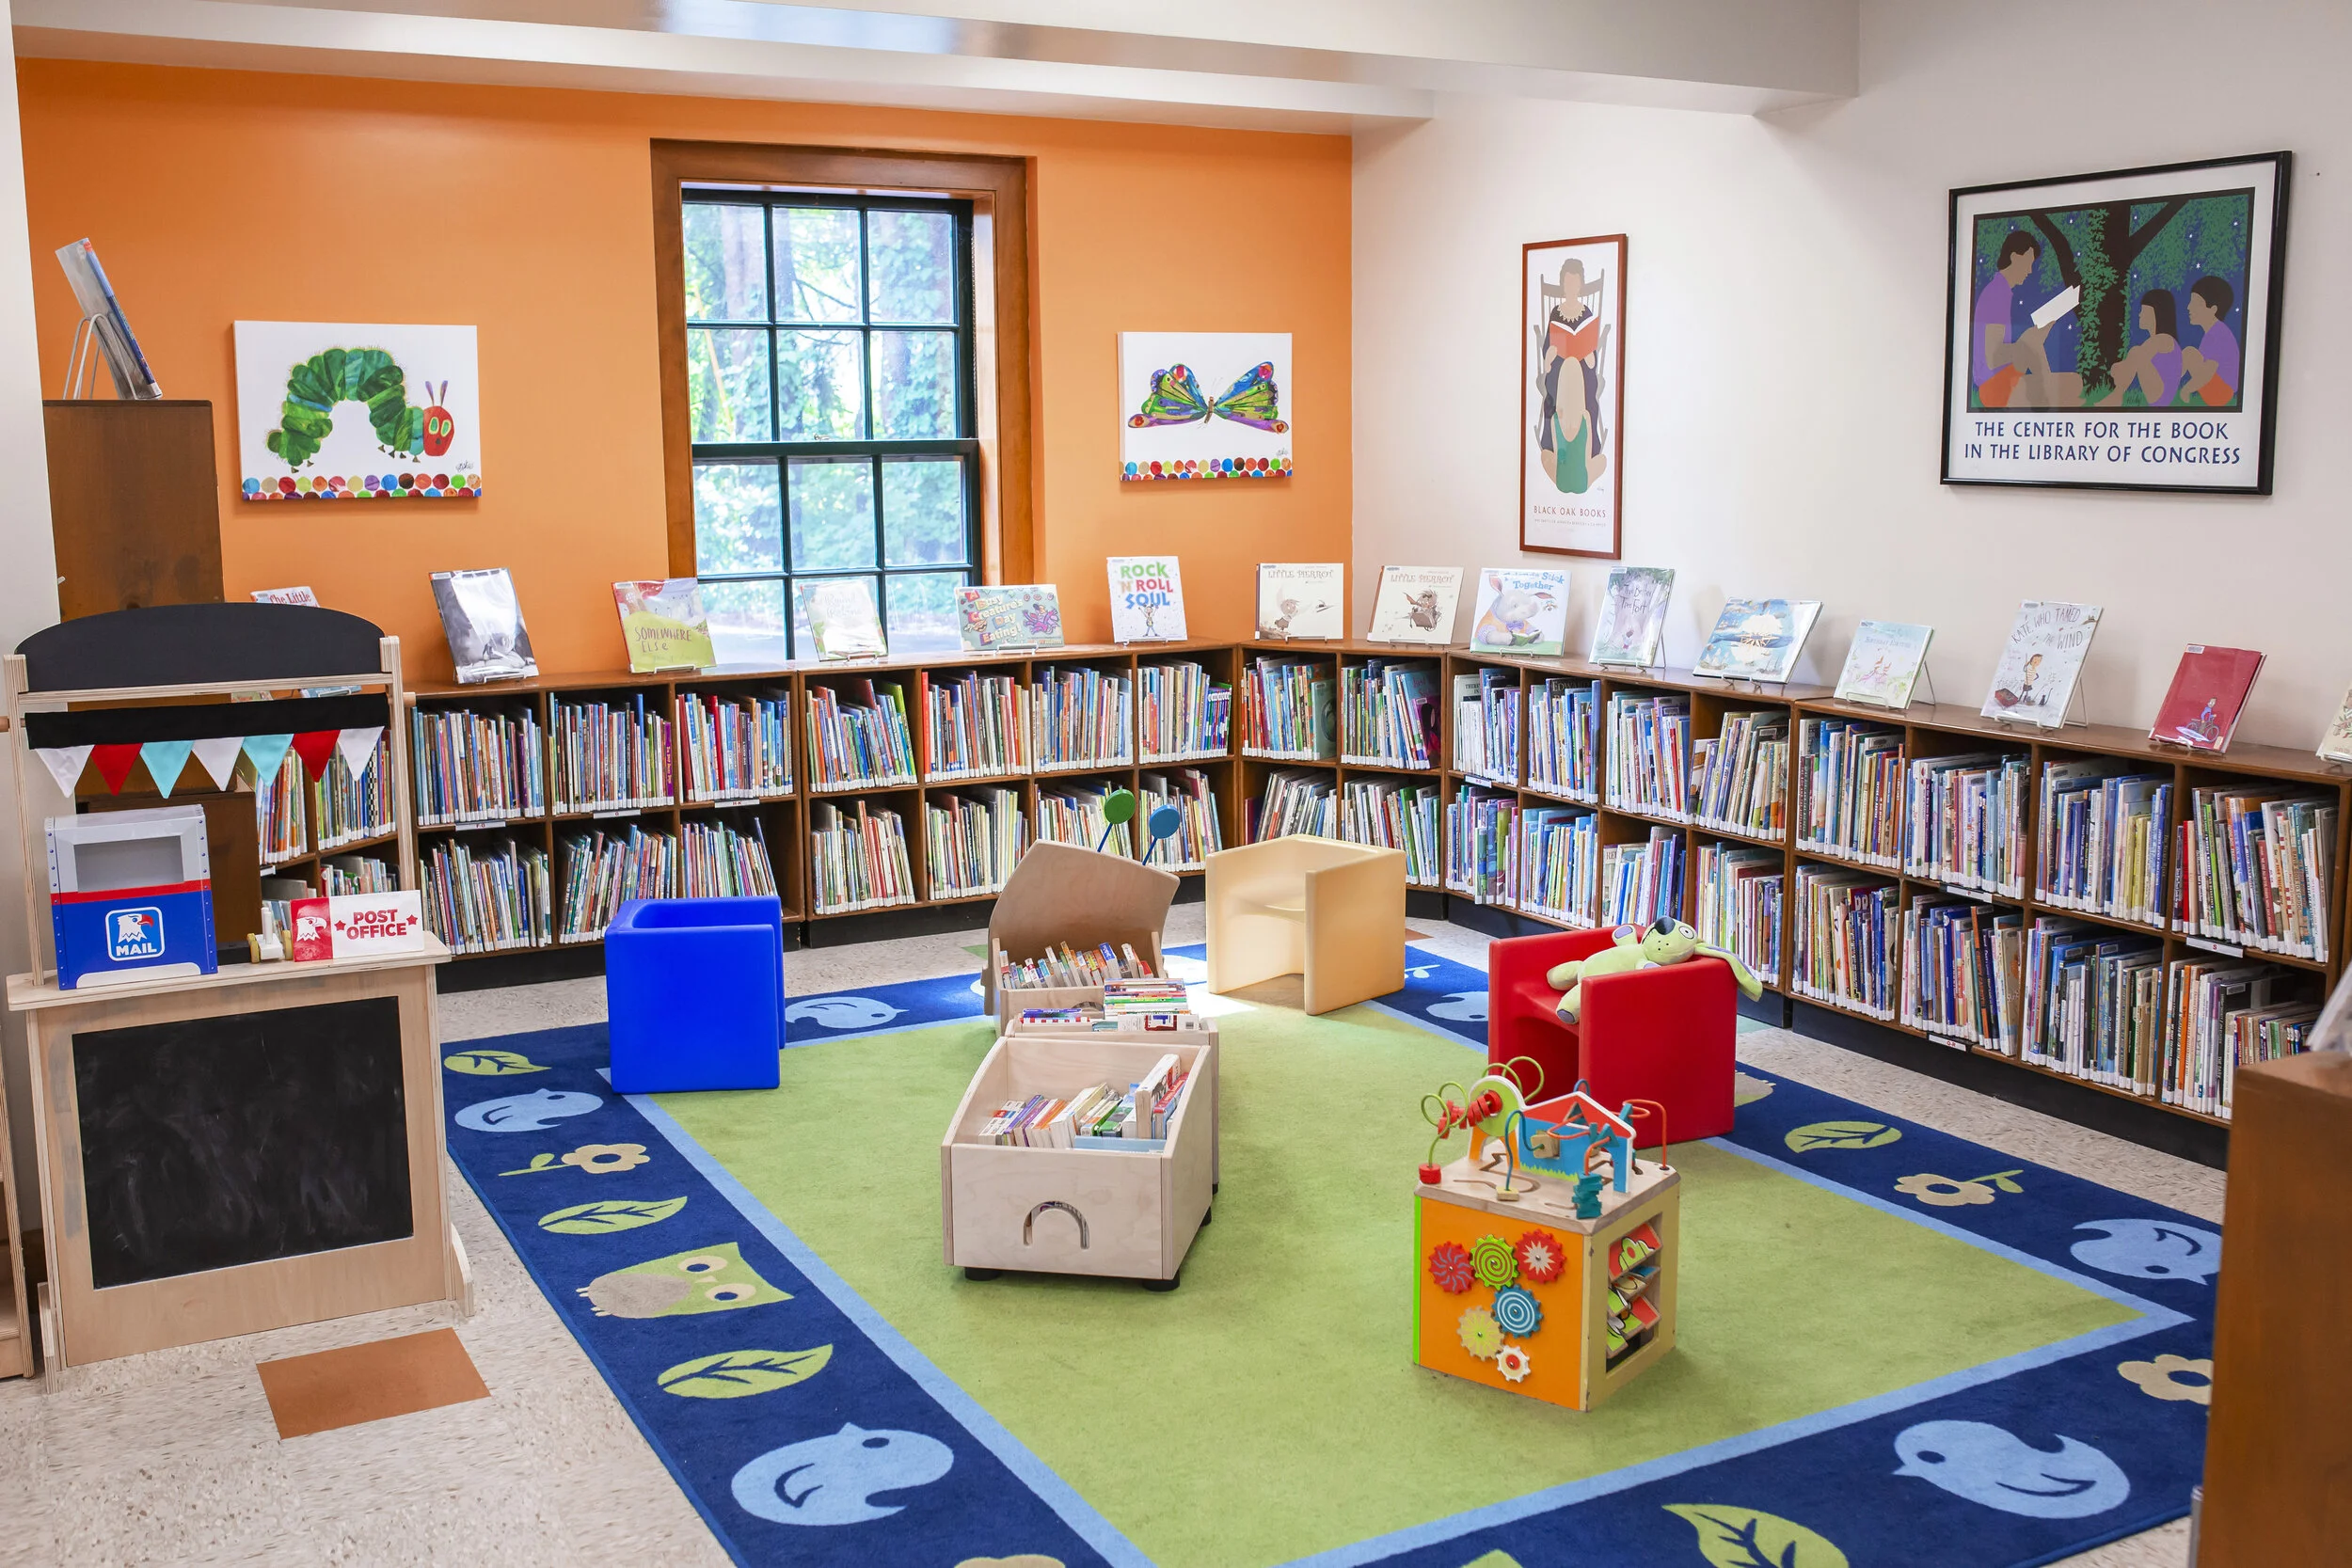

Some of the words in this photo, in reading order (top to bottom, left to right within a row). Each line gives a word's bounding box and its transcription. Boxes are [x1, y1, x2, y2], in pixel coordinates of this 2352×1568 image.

[1976, 421, 2005, 437] THE
[2013, 421, 2075, 438] CENTER
[2085, 421, 2121, 438] FOR
[2128, 422, 2161, 439] THE
[2171, 422, 2229, 440] BOOK
[1964, 444, 1981, 459] IN
[1991, 444, 2020, 460] THE
[2028, 444, 2099, 461] LIBRARY
[2107, 446, 2132, 463] OF
[2141, 446, 2241, 465] CONGRESS
[1534, 506, 1556, 515] BLACK
[1560, 508, 1576, 516] OAK
[1581, 509, 1606, 517] BOOKS
[1120, 562, 1169, 578] ROCK
[1542, 572, 1565, 584] Stick
[1136, 578, 1173, 593] ROLL
[1513, 581, 1554, 591] Together
[287, 591, 311, 604] Little
[1125, 593, 1170, 610] SOUL
[995, 613, 1016, 626] Day
[2034, 611, 2051, 628] WHO
[2056, 608, 2081, 623] TAMED
[635, 626, 691, 641] SOMEWHERE
[2058, 630, 2083, 649] WIND
[353, 909, 398, 926] POST
[346, 924, 407, 941] OFFICE
[117, 942, 158, 958] MAIL
